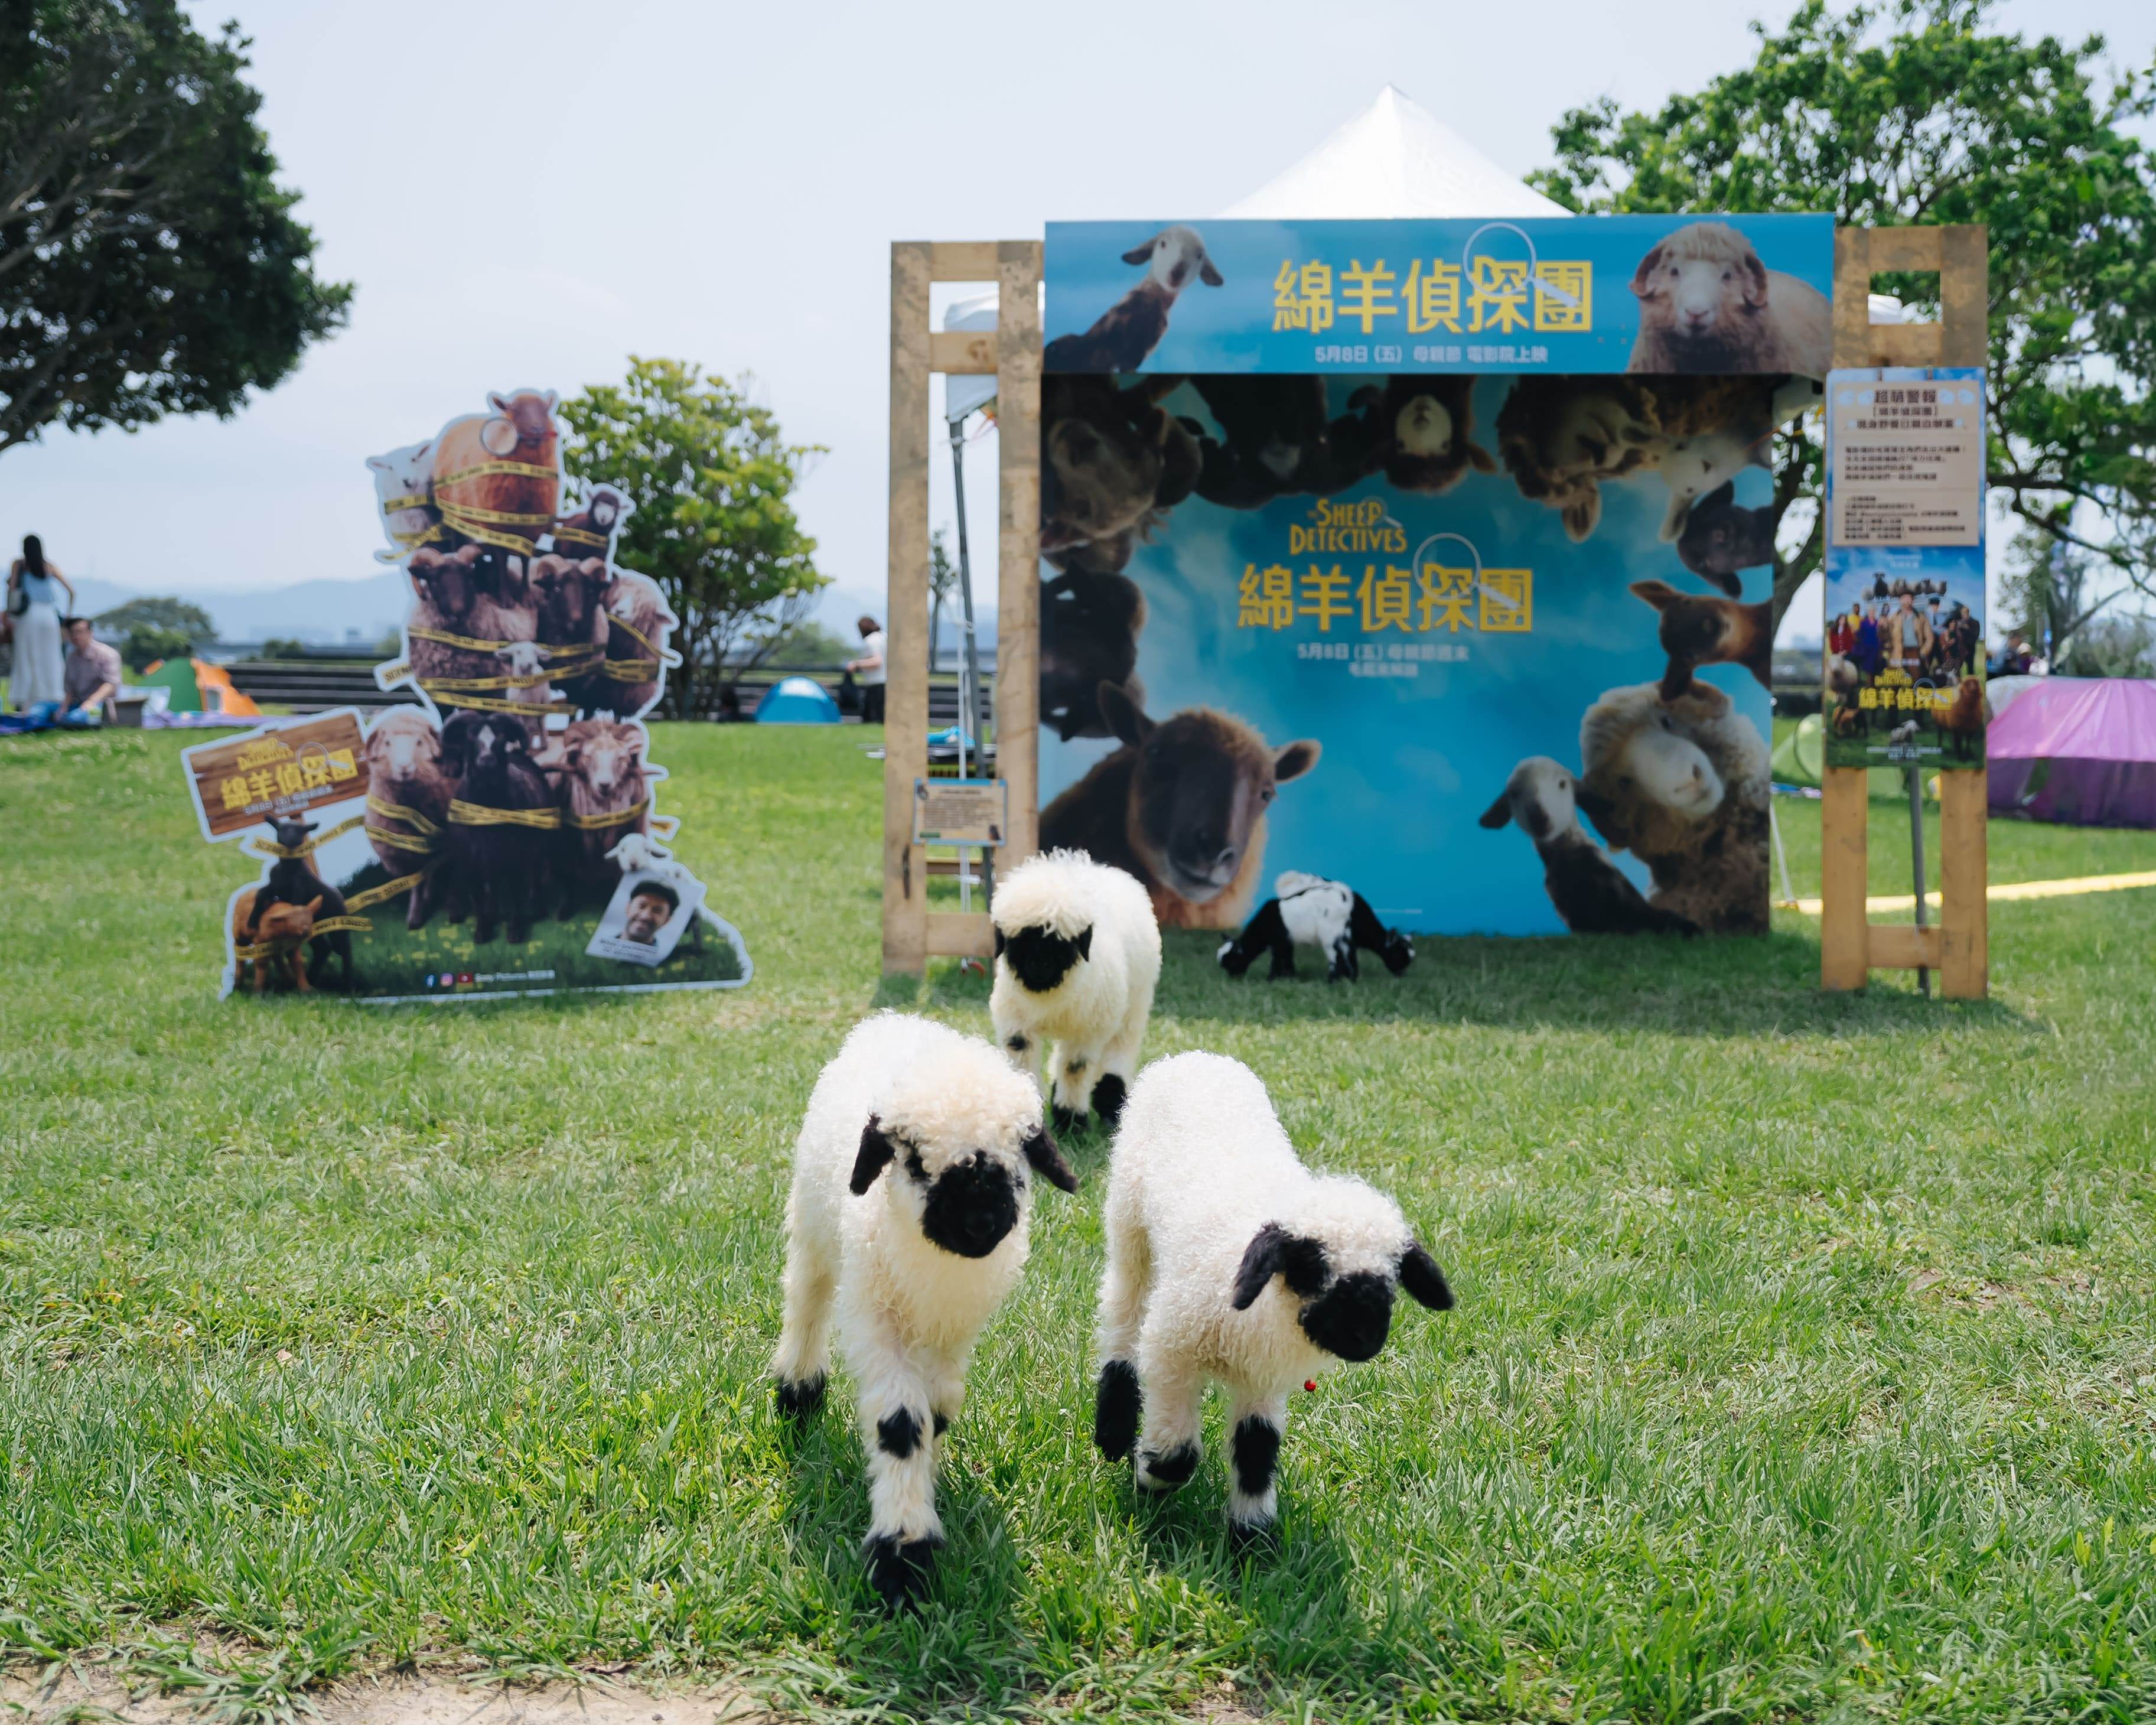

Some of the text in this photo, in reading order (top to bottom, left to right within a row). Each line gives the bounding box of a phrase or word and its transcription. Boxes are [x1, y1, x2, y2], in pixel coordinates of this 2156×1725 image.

[1272, 258, 1593, 334] 綿羊偵探團
[1314, 344, 1368, 363] 5月8日
[1317, 498, 1383, 528] SHEEP
[1289, 523, 1408, 556] DETECTIVES
[1237, 562, 1534, 633] 綿羊偵探團
[220, 747, 359, 811] 綿羊偵探團
